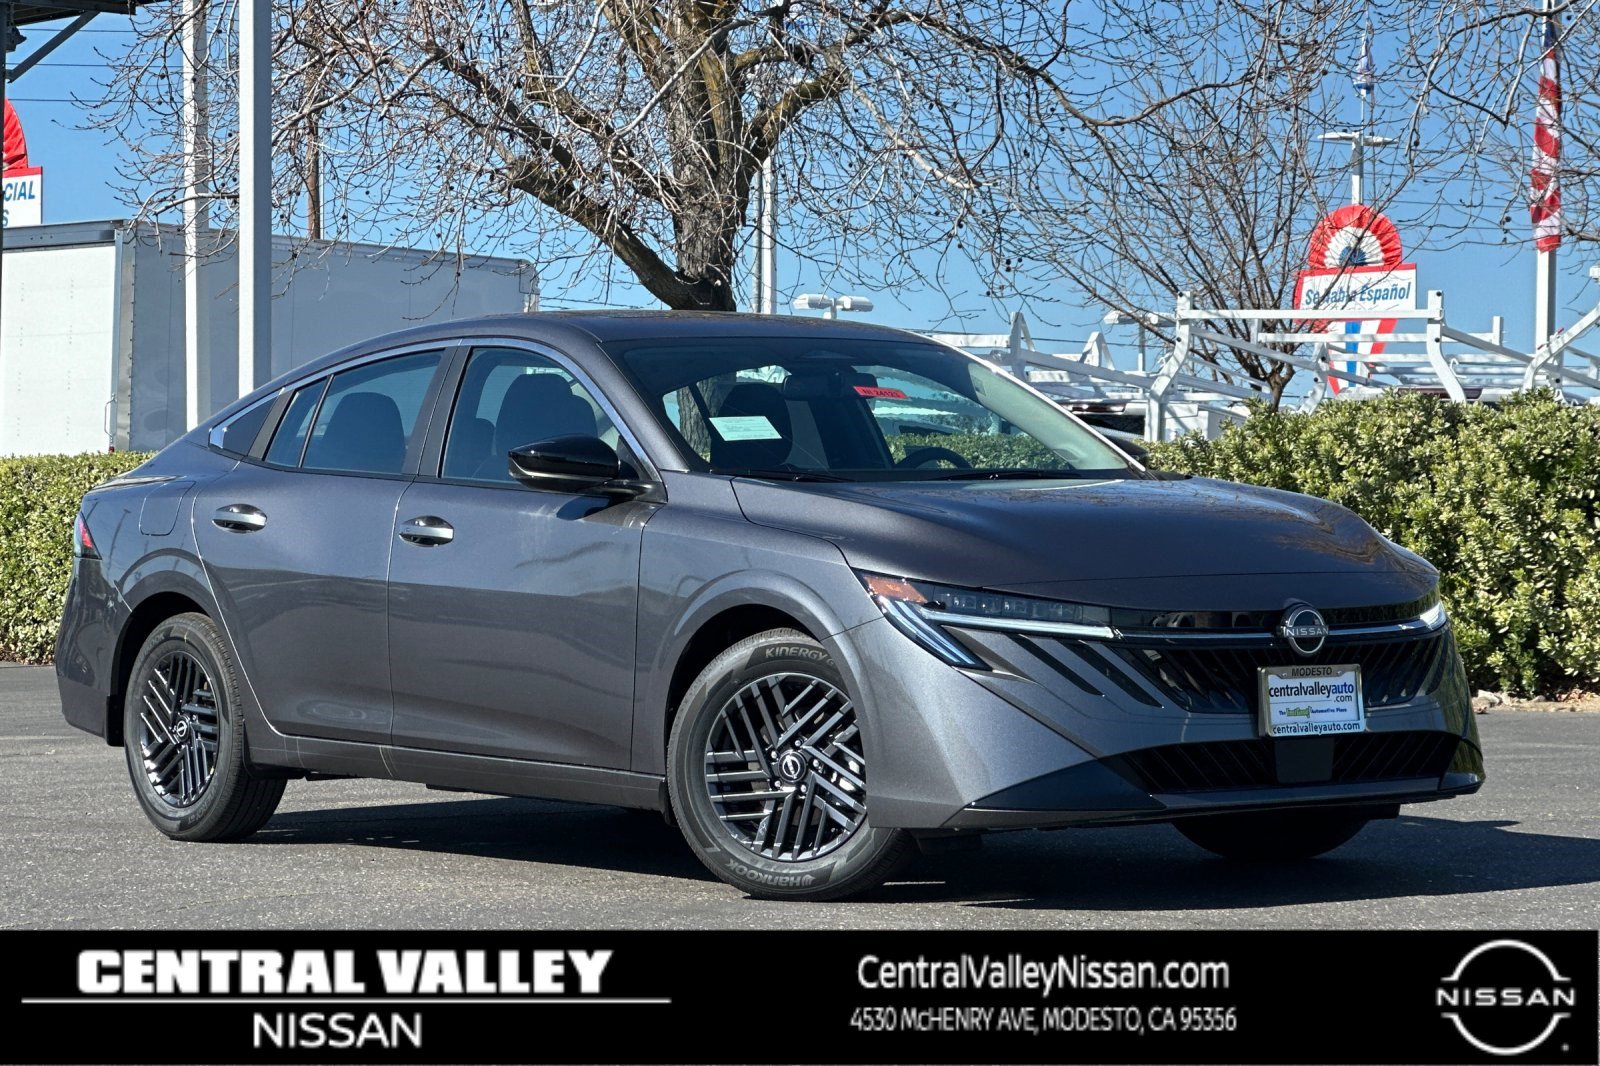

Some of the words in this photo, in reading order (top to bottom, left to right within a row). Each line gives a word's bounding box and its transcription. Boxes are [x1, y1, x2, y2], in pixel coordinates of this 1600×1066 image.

[1359, 282, 1412, 304] Español
[1286, 627, 1329, 636] NISSAN
[765, 646, 828, 662] KINERGY
[1291, 666, 1333, 677] MODESTO
[1269, 681, 1354, 699] centralvalleyauto
[1333, 694, 1353, 703] .com
[1272, 721, 1360, 735] centralvalleyauto.com
